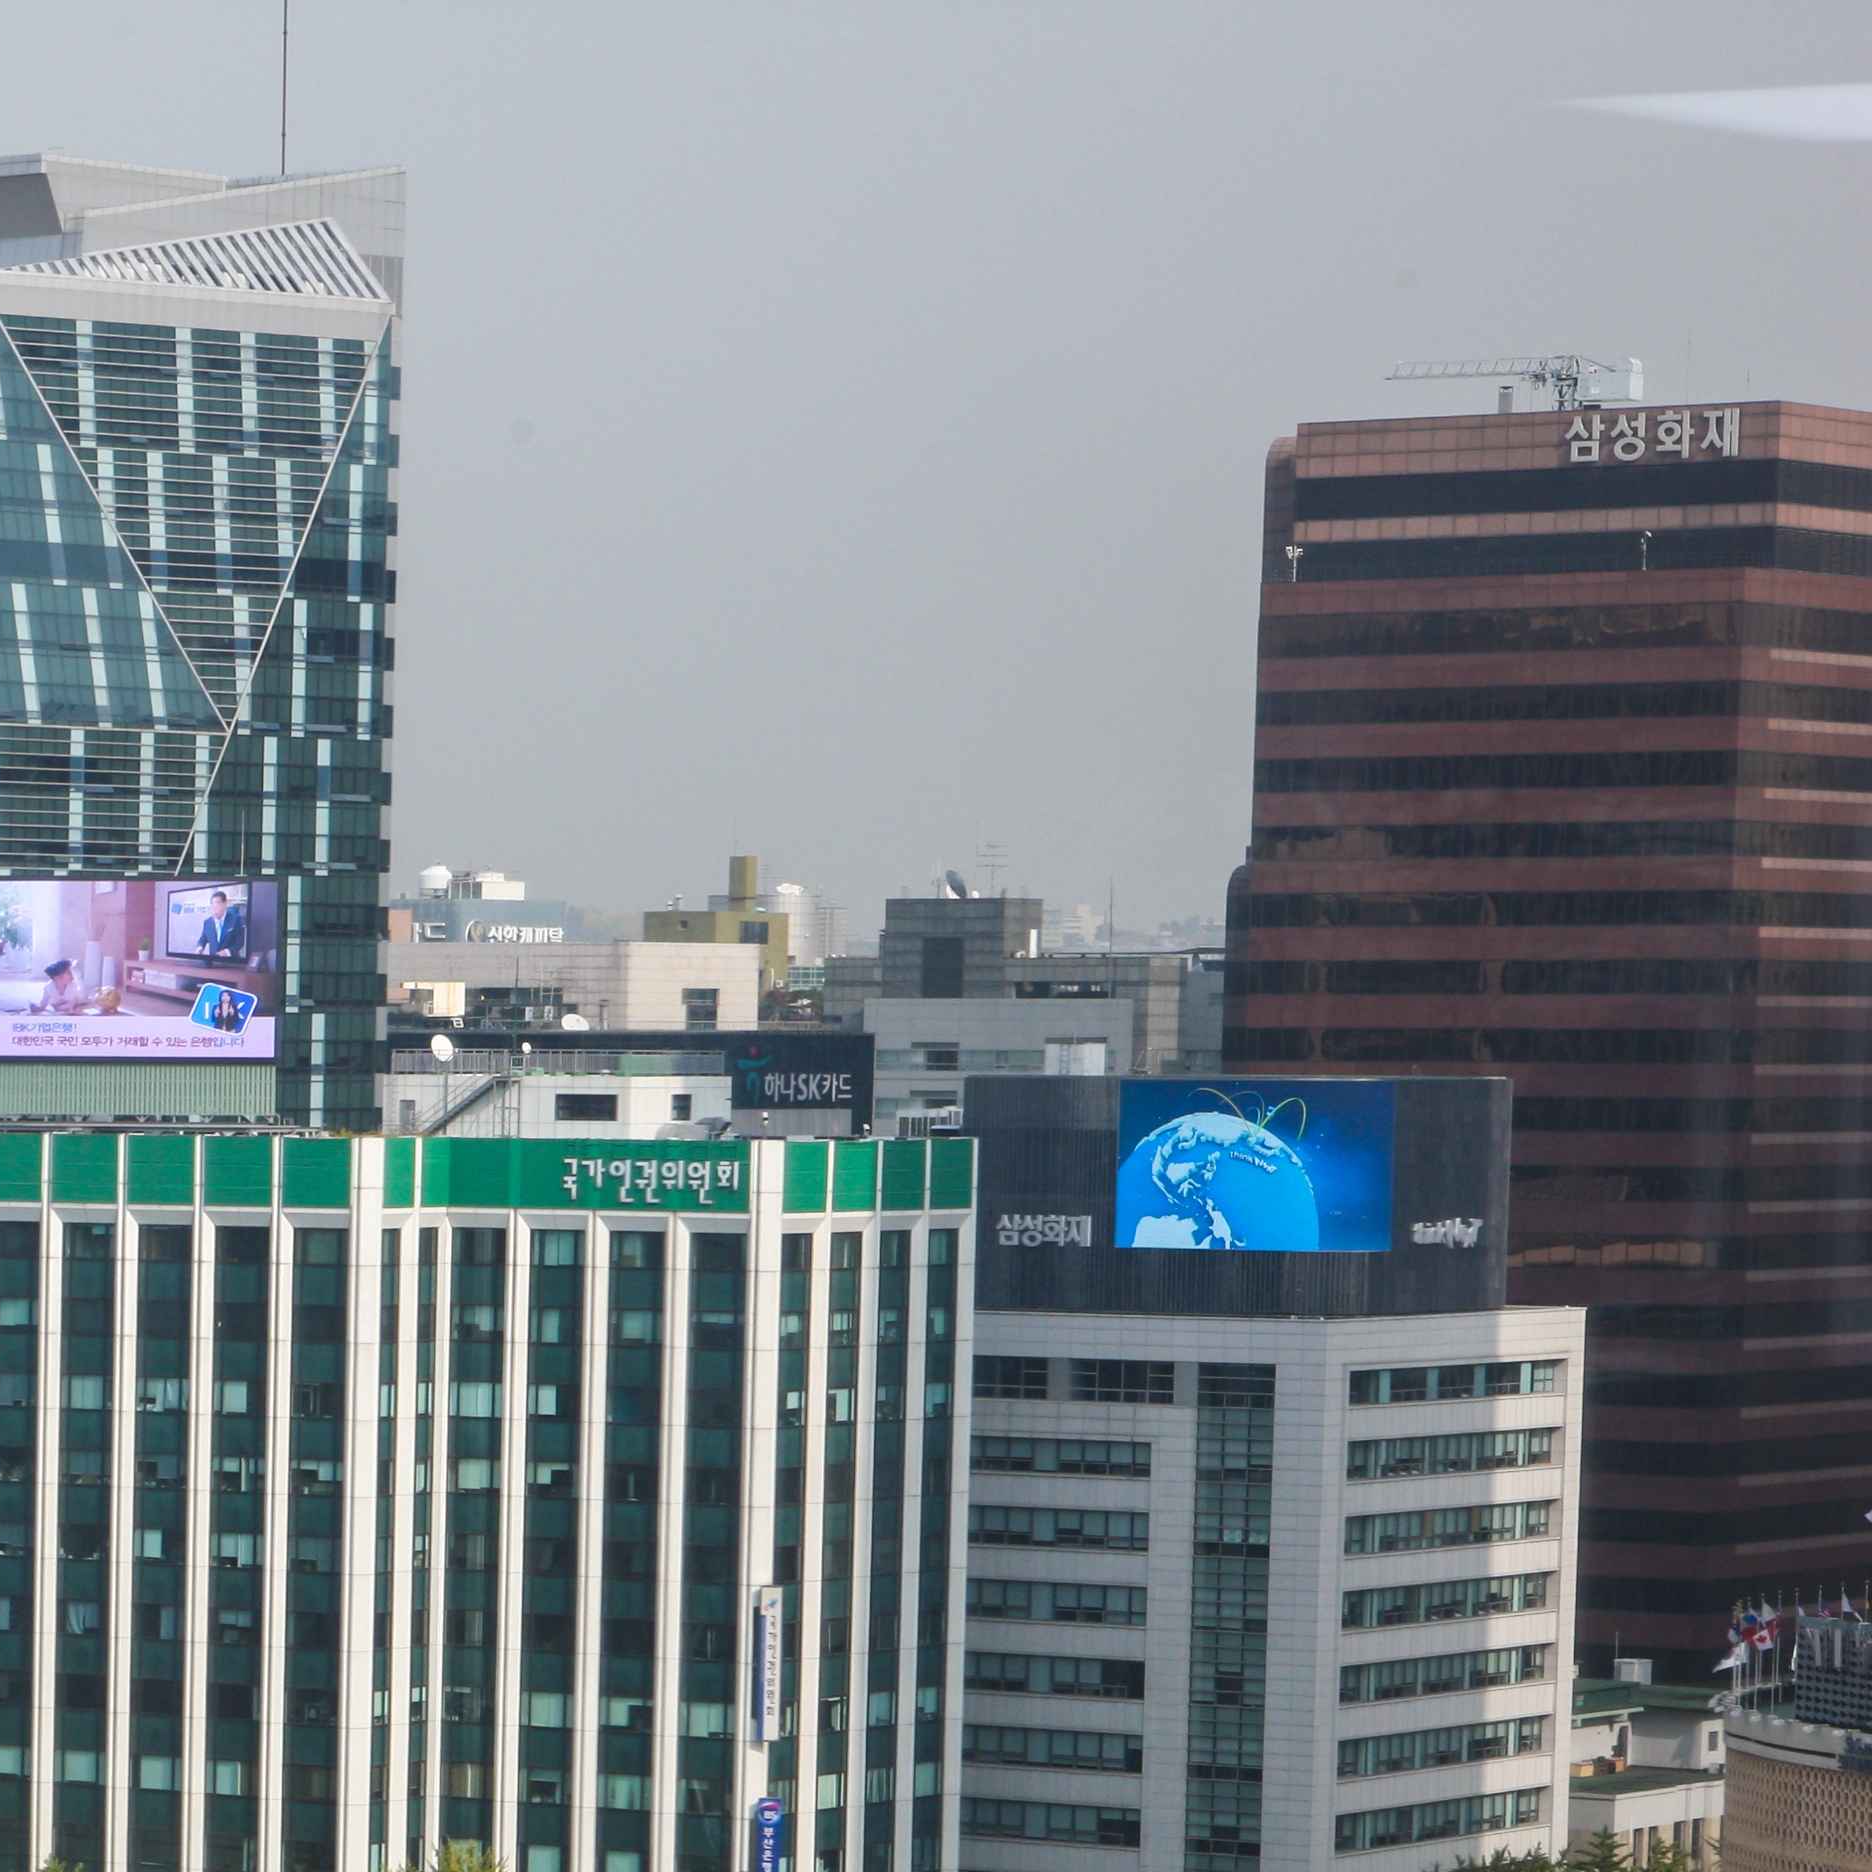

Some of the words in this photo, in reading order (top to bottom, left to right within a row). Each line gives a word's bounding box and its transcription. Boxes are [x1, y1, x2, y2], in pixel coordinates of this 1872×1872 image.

[1565, 407, 1740, 462] 삼성화재
[764, 1072, 852, 1103] 하나SK카드
[562, 1157, 740, 1204] 국가인권위원회
[996, 1213, 1092, 1248] 삼성화재
[761, 1827, 775, 1872] 부산은행
